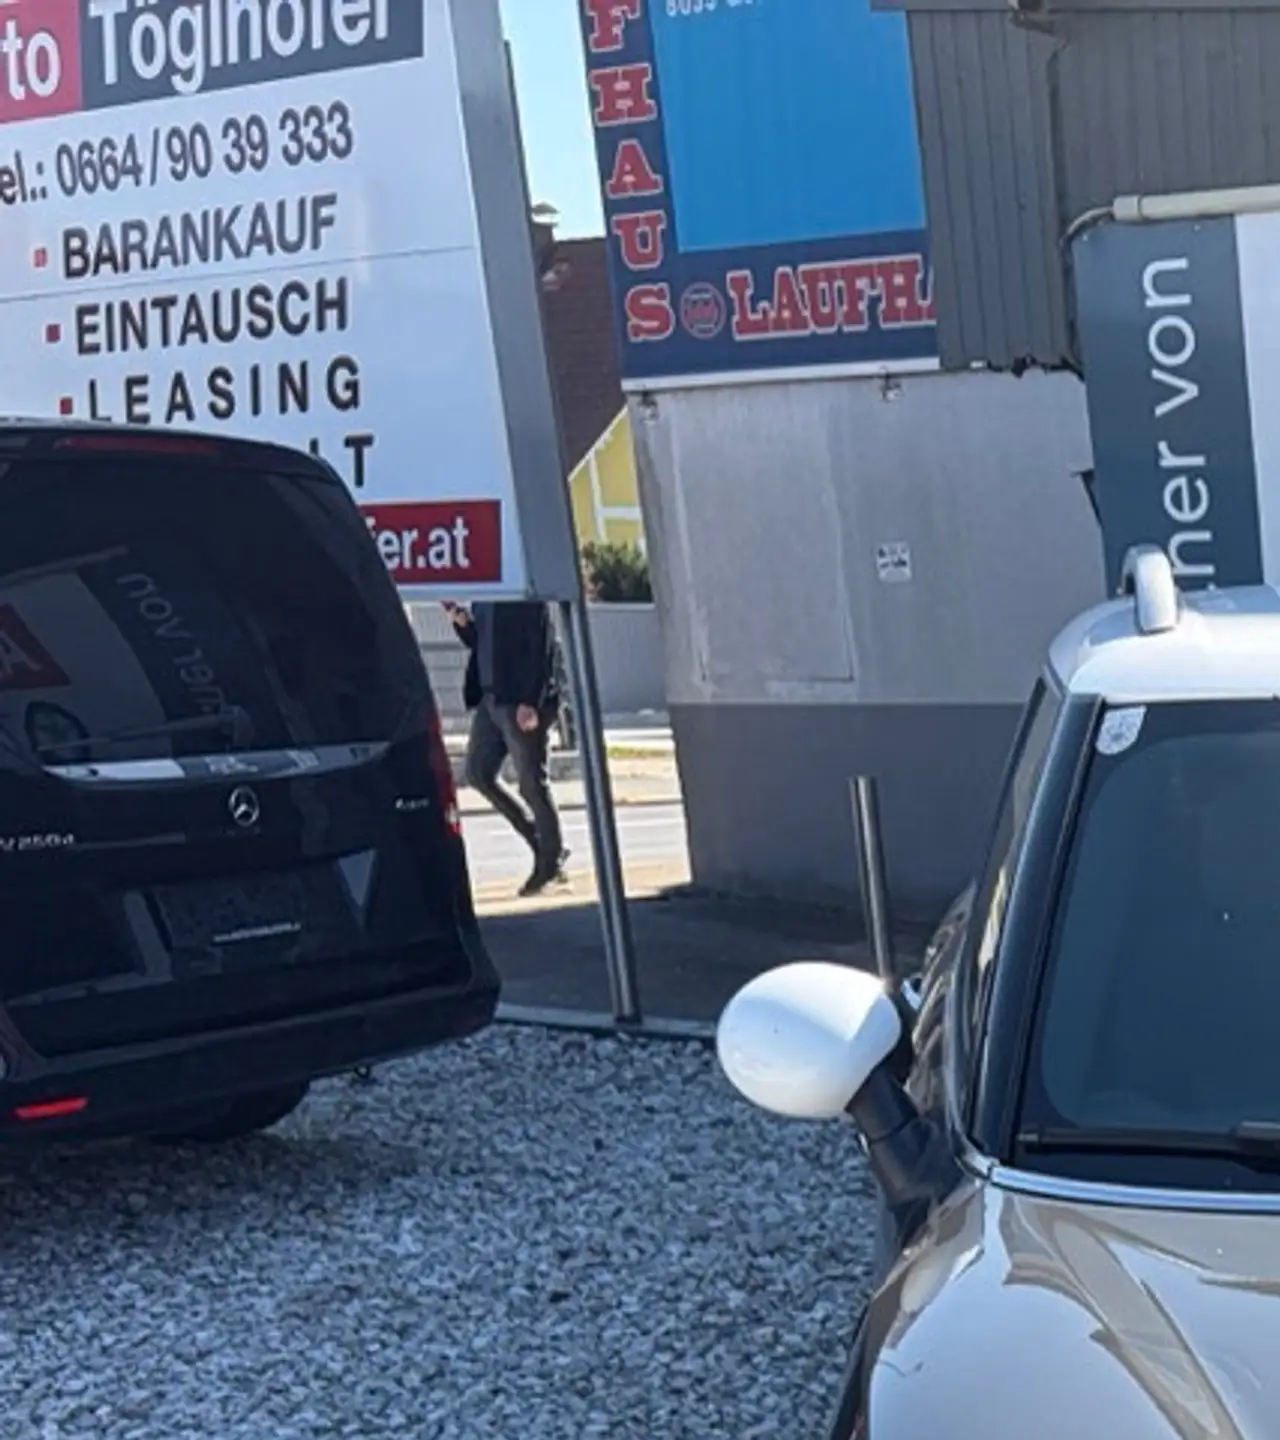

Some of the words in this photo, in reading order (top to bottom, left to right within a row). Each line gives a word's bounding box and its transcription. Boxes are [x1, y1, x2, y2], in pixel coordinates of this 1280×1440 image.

[221, 114, 269, 174] 39
[278, 100, 353, 166] 333
[63, 194, 338, 280] BARANKAUF
[77, 277, 349, 355] EINTAUSCH
[1142, 256, 1200, 419] von
[90, 355, 361, 424] LEASING
